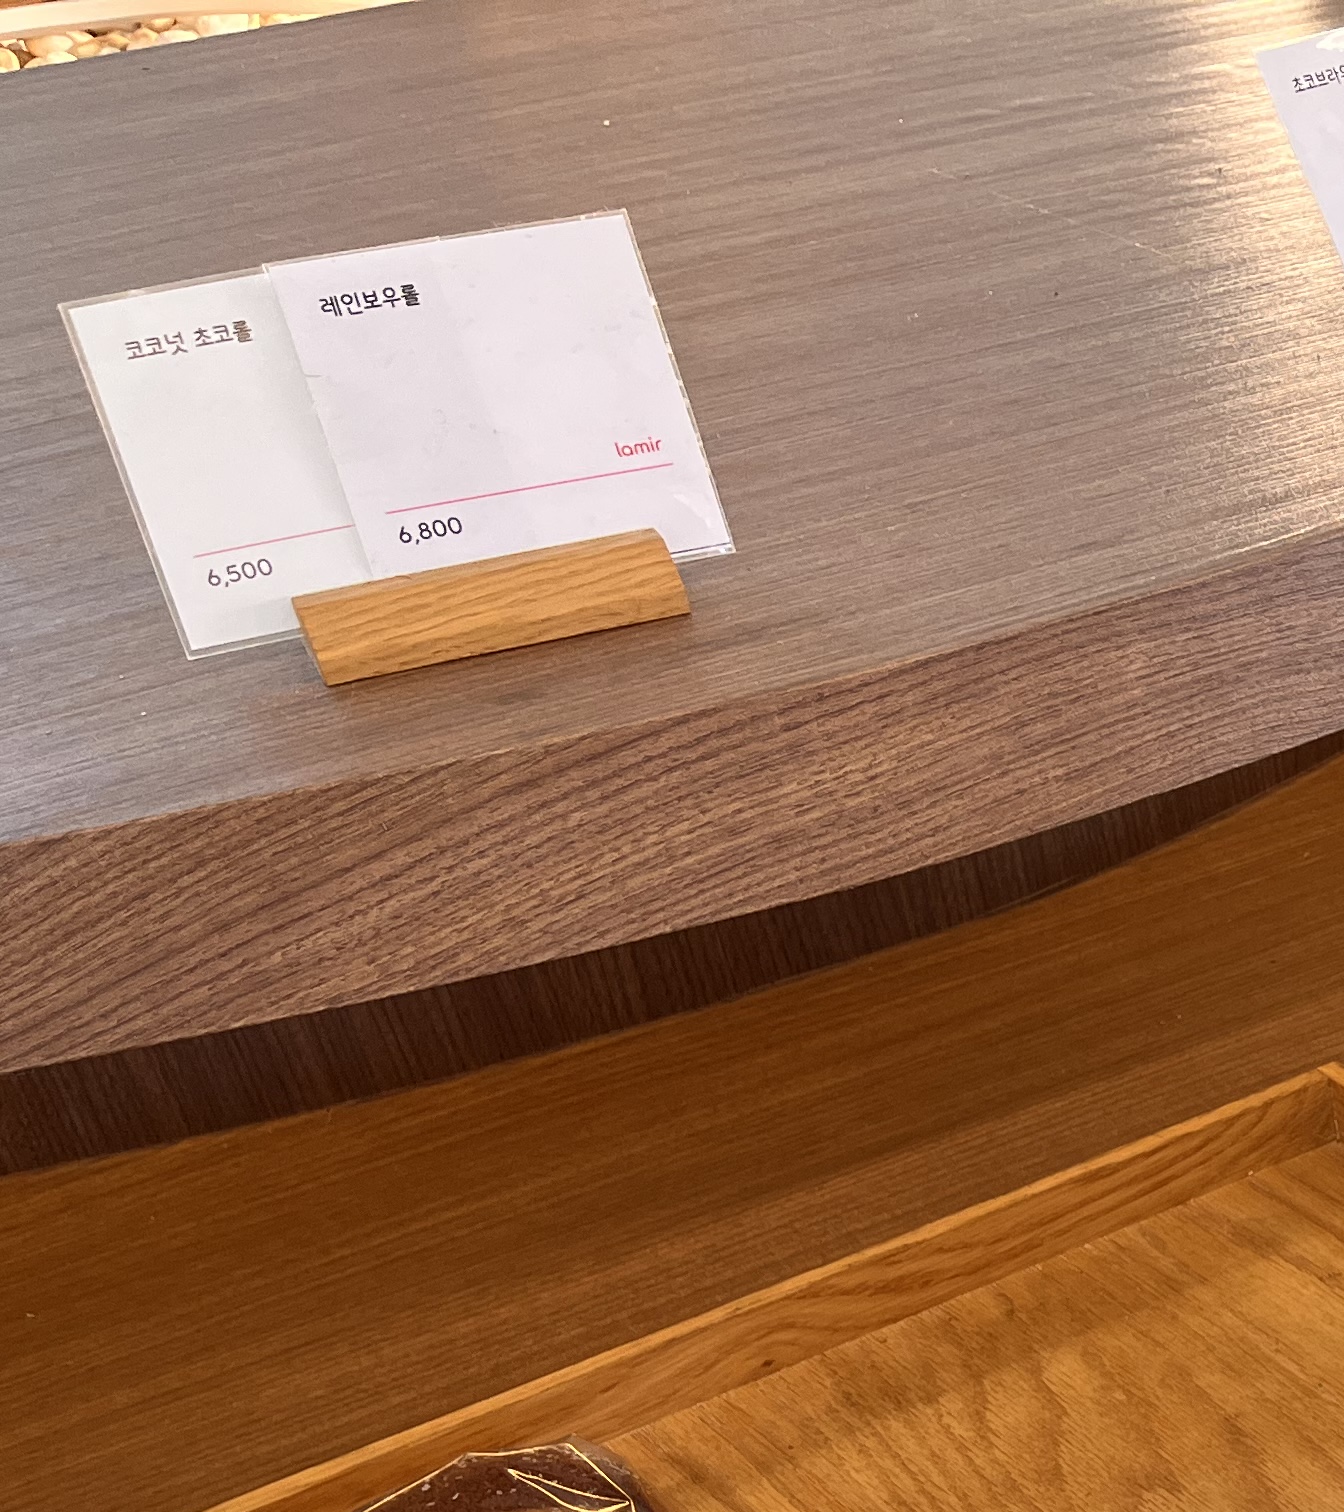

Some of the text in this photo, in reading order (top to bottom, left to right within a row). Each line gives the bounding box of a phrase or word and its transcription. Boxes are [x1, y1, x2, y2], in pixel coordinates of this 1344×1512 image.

[319, 284, 420, 316] 레인보우롤
[125, 320, 253, 360] 코코넛 초코롤
[615, 437, 662, 458] lamir
[399, 517, 463, 546] 6,800
[207, 558, 273, 588] 6,500
